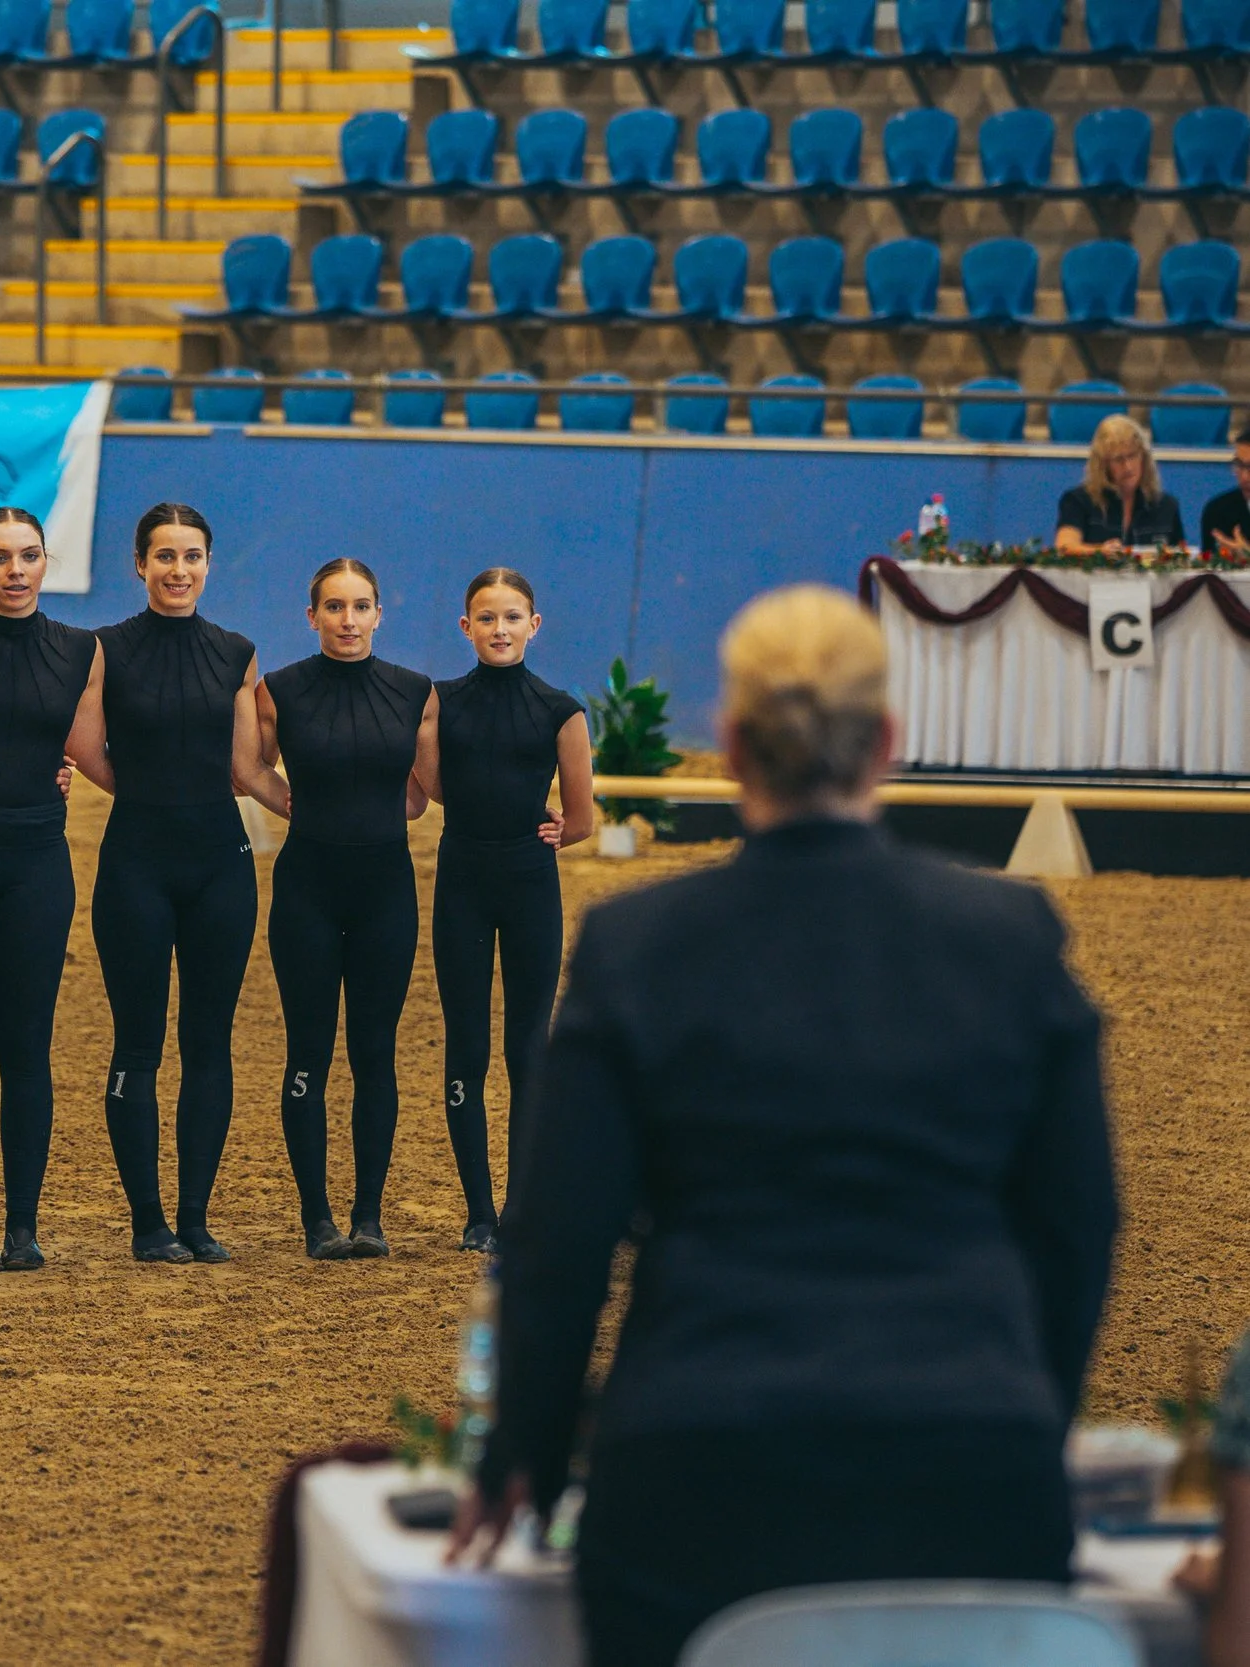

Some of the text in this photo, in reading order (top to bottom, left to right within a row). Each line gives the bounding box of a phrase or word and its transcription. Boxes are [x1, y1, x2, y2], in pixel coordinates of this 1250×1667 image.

[1102, 612, 1143, 657] C
[110, 1071, 126, 1098] 1
[291, 1071, 309, 1097] 5
[449, 1080, 465, 1106] 3
